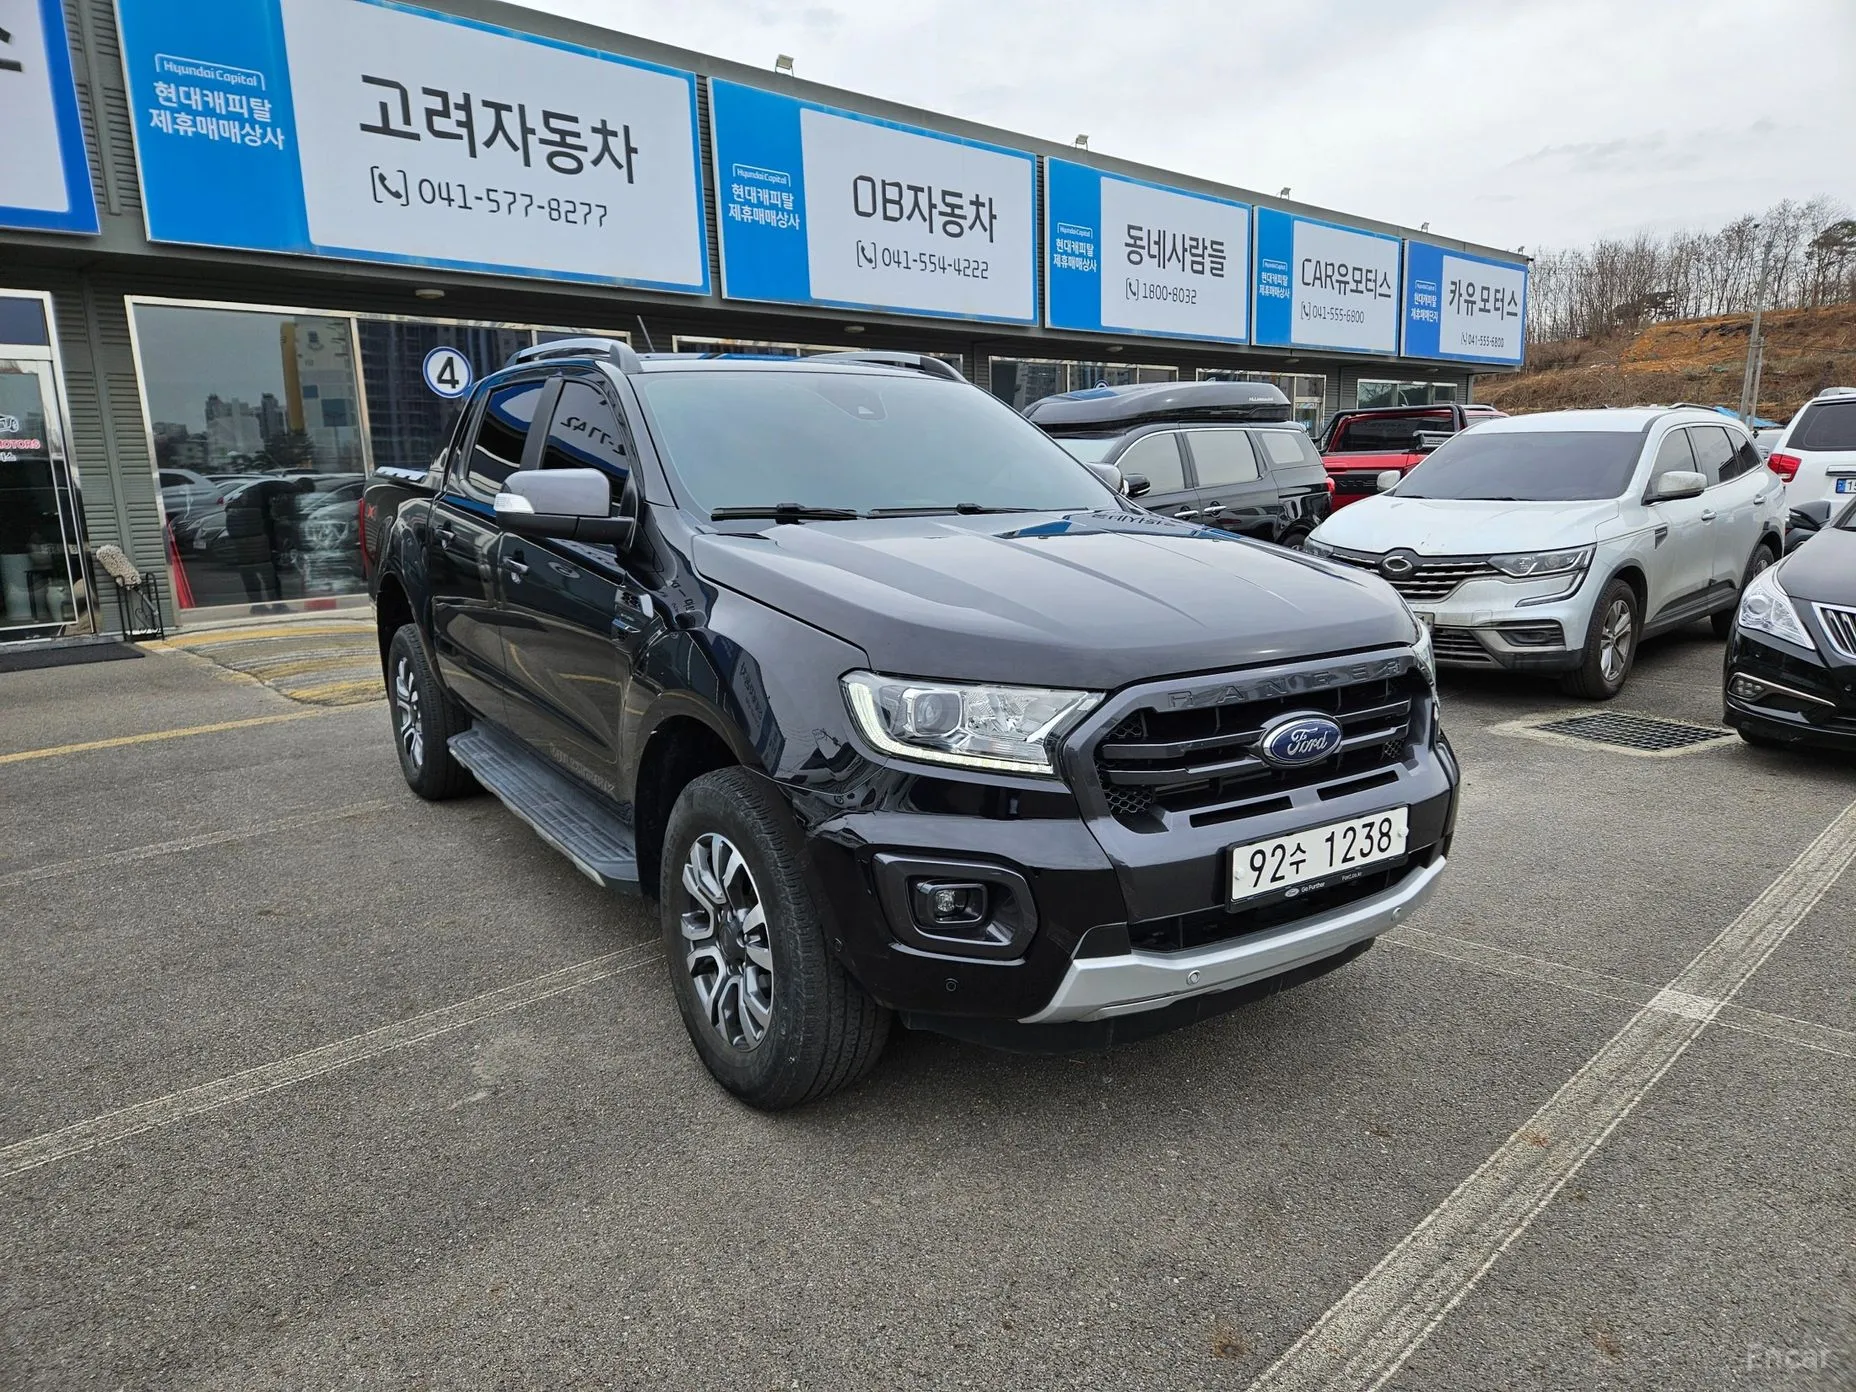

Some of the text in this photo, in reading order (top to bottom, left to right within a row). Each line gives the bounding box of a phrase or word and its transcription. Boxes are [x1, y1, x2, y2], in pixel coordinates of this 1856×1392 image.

[163, 60, 258, 86] Hyundai Capital
[153, 81, 272, 123] 현대캐피탈
[148, 108, 285, 151] 제휴매매상사
[359, 74, 639, 185] 고려자동차
[418, 178, 608, 228] 041-577-8277
[731, 183, 795, 211] 현대캐피탈
[853, 175, 998, 244] OB자동차
[728, 203, 801, 231] 제휴매매상사
[882, 247, 989, 280] 041-554-4222
[1053, 254, 1097, 273] 제휴매매상사
[1056, 238, 1094, 257] 현대캐피탈
[1124, 223, 1227, 279] 동네사람들
[1142, 283, 1197, 304] 1800-8032
[1301, 258, 1391, 300] CAR유모터스
[1312, 305, 1365, 323] 041-555-6800
[1449, 280, 1518, 321] 카유모터스
[436, 356, 460, 389] 4
[1167, 659, 1401, 709] RANGER
[1287, 728, 1328, 754] Ford
[1249, 817, 1393, 888] 92수 1238
